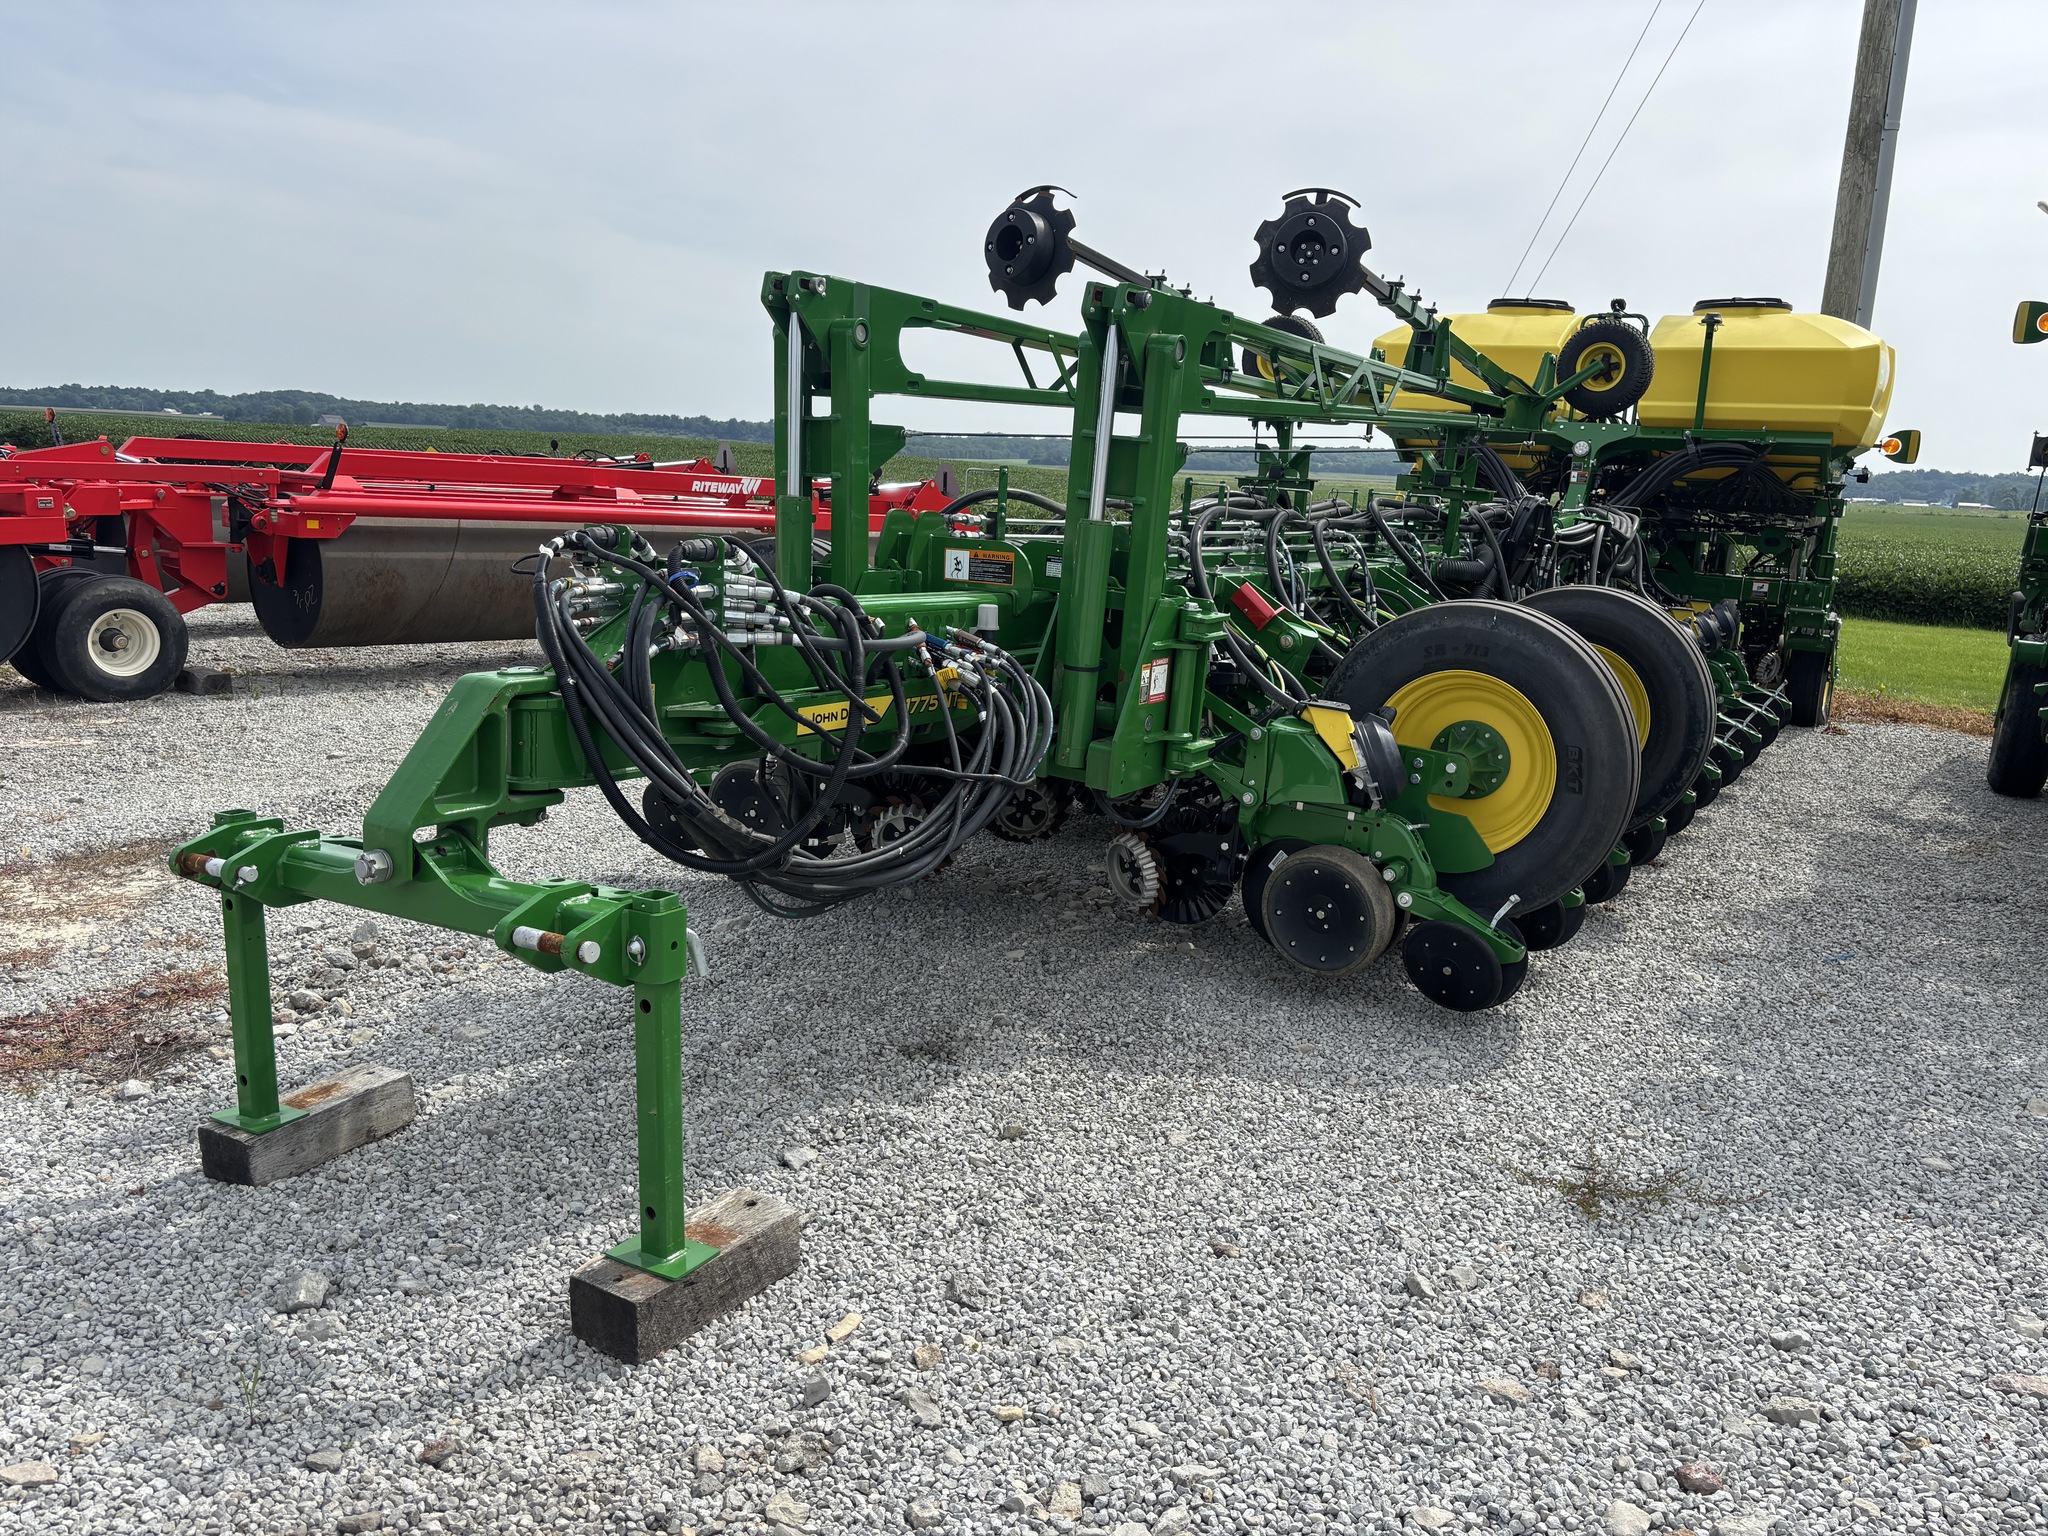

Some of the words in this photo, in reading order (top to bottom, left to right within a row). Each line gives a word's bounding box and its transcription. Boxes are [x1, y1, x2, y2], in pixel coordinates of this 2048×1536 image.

[692, 481, 742, 494] RITEWAY
[982, 553, 1010, 561] WARNING
[906, 695, 939, 714] 1775
[812, 711, 838, 725] JOHN
[1567, 746, 1583, 795] BKT
